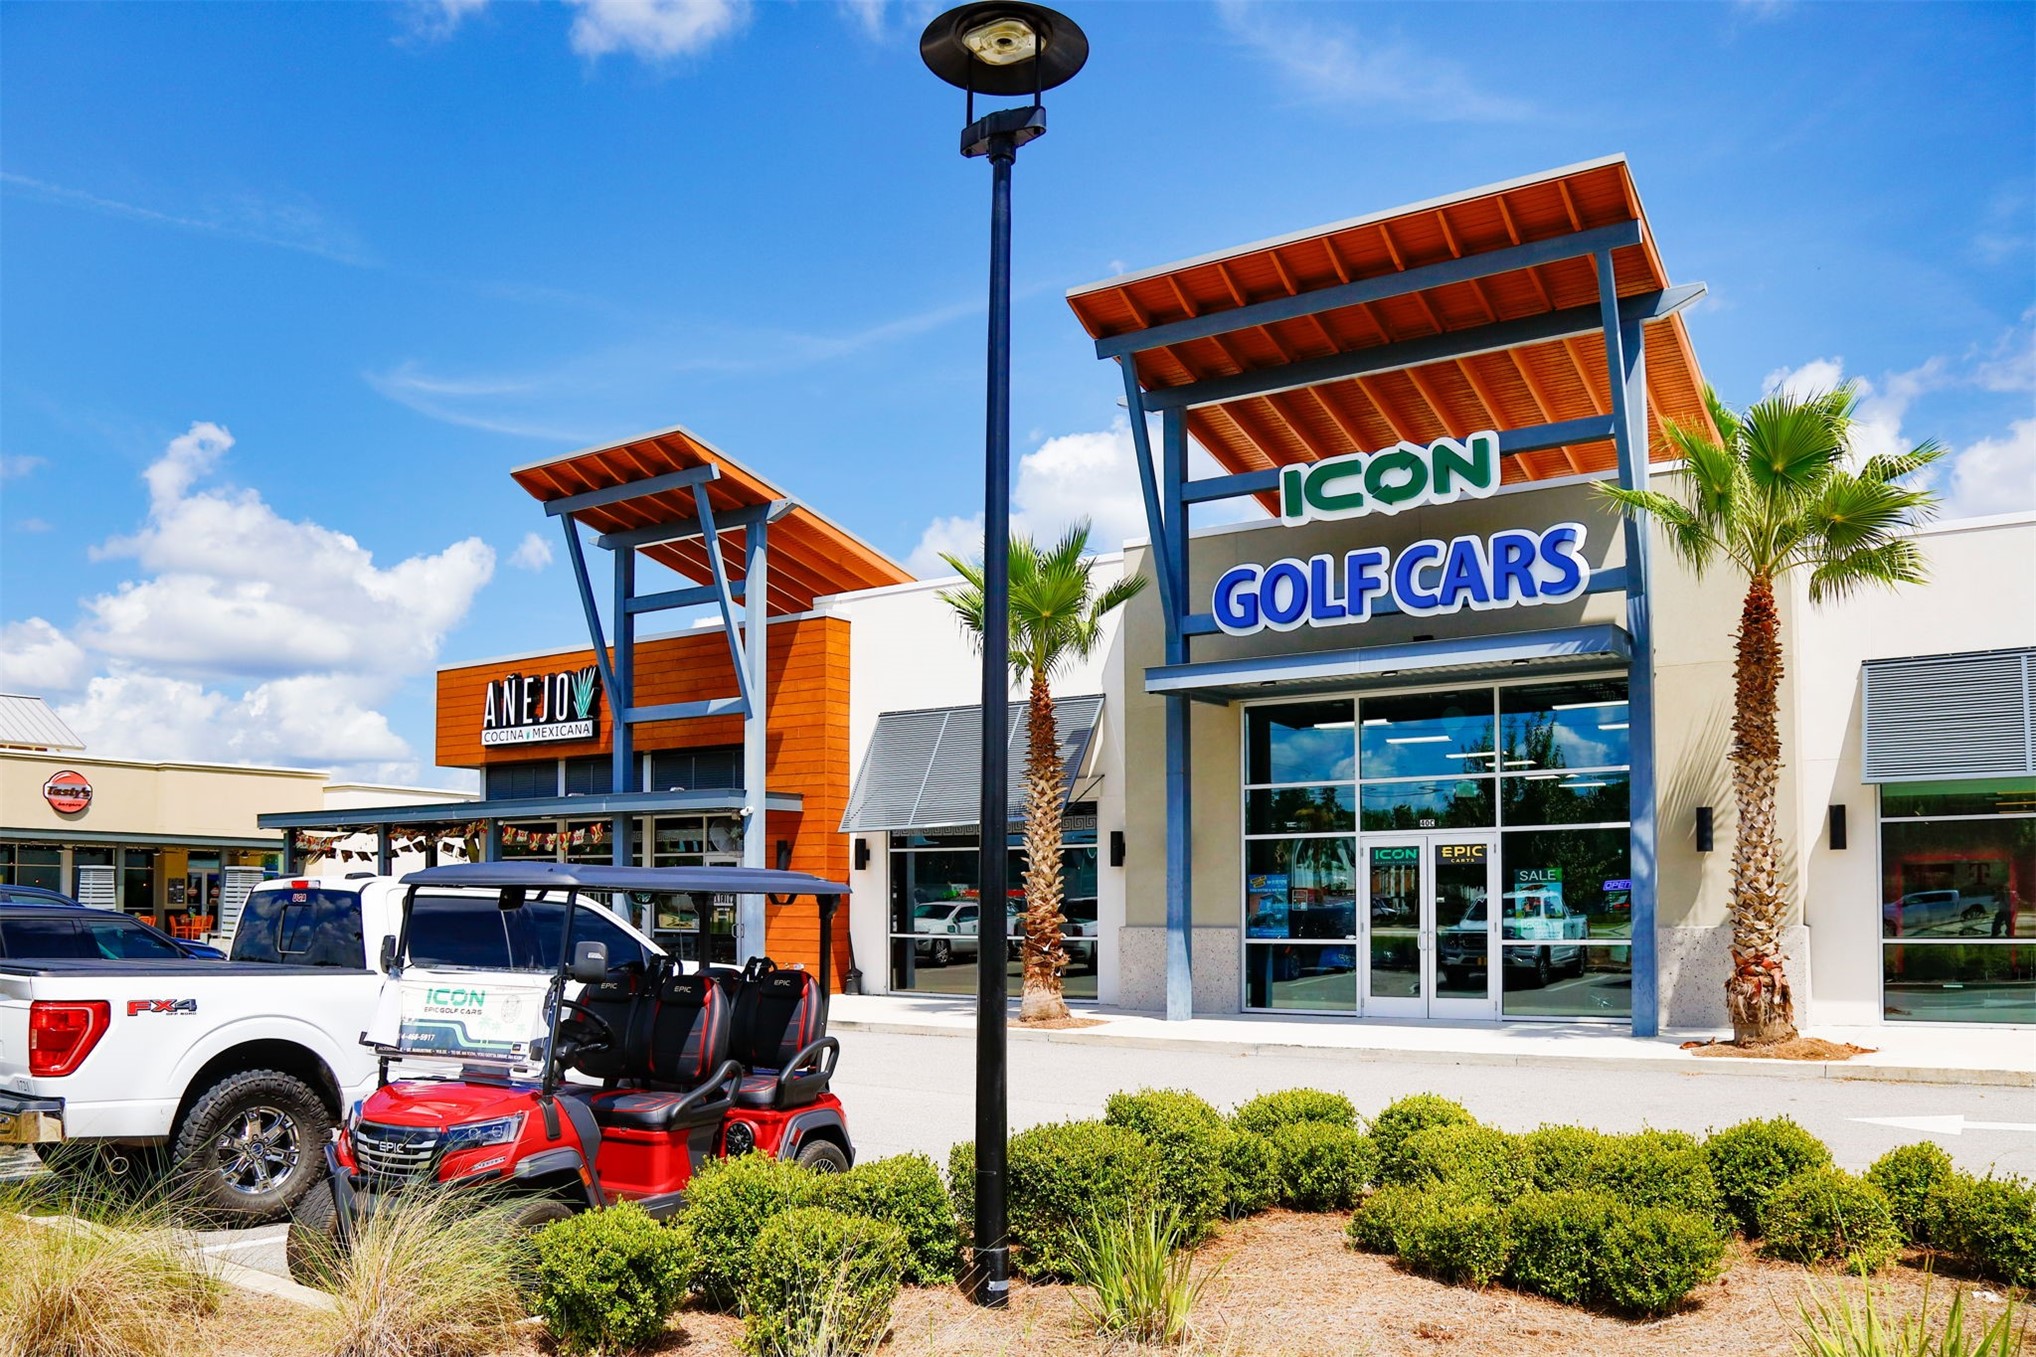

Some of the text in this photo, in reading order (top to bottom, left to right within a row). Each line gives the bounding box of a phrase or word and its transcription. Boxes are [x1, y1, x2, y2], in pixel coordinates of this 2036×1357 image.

[1283, 436, 1492, 519] ICON
[1214, 528, 1582, 630] GOLF CARS
[484, 672, 569, 728] AÑEJO
[484, 723, 591, 743] COCINA MEXICANA
[47, 786, 92, 799] Tasty's
[1375, 848, 1418, 860] ICON
[1442, 845, 1483, 857] EPIC
[1520, 869, 1557, 881] SALE
[600, 982, 618, 990] EPIC
[673, 985, 692, 993] EPIC
[774, 979, 791, 987] EPIC
[425, 988, 486, 1007] ICON
[127, 999, 197, 1016] FX4
[424, 1006, 440, 1014] EPIC
[379, 1141, 404, 1153] EPIC
